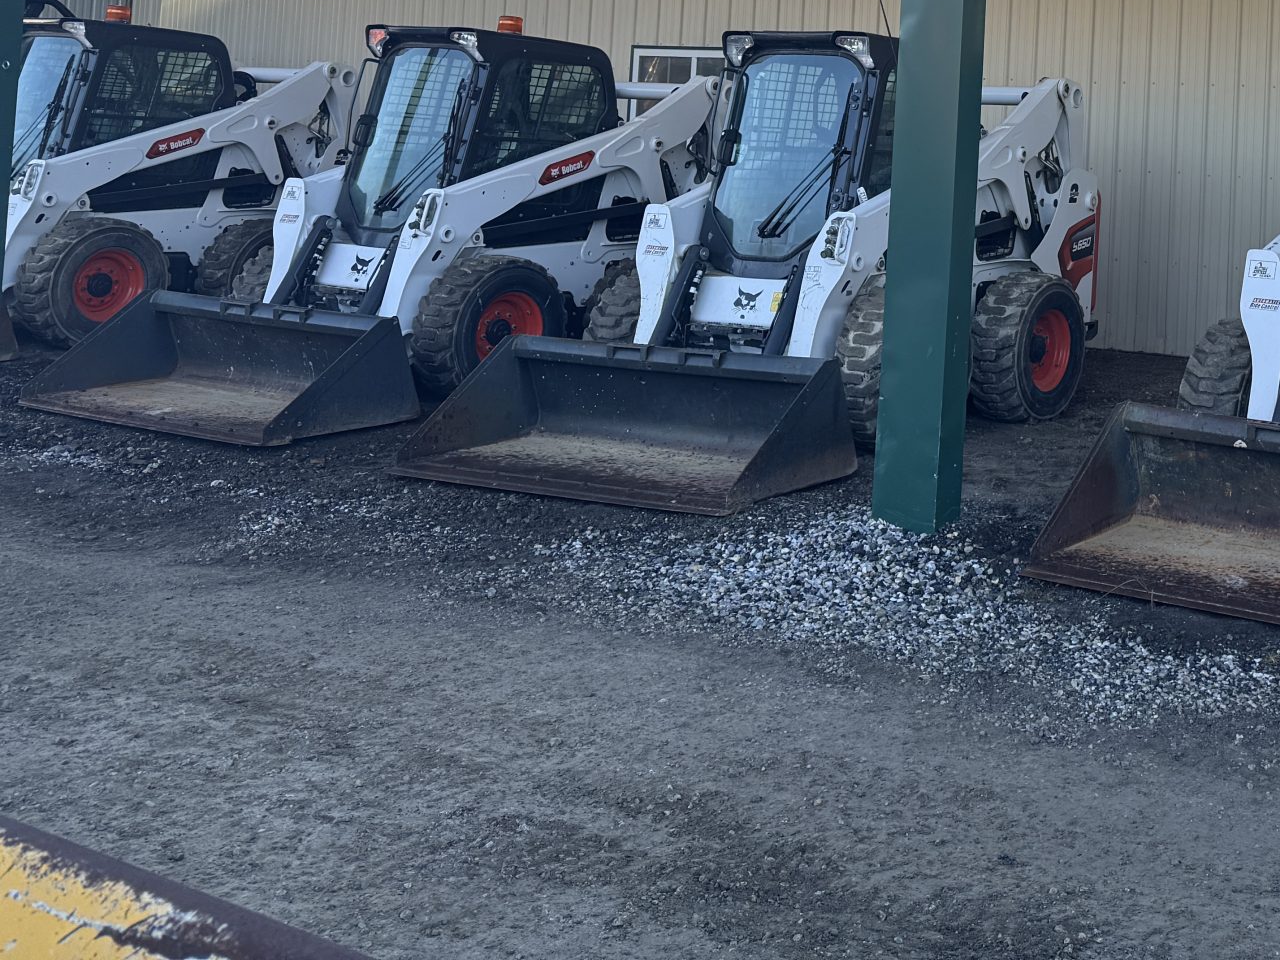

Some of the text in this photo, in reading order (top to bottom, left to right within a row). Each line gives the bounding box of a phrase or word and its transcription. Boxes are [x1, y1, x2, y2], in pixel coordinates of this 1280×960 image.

[170, 136, 193, 150] Bobcat
[561, 160, 585, 175] Bobcat
[1072, 236, 1092, 253] S650
